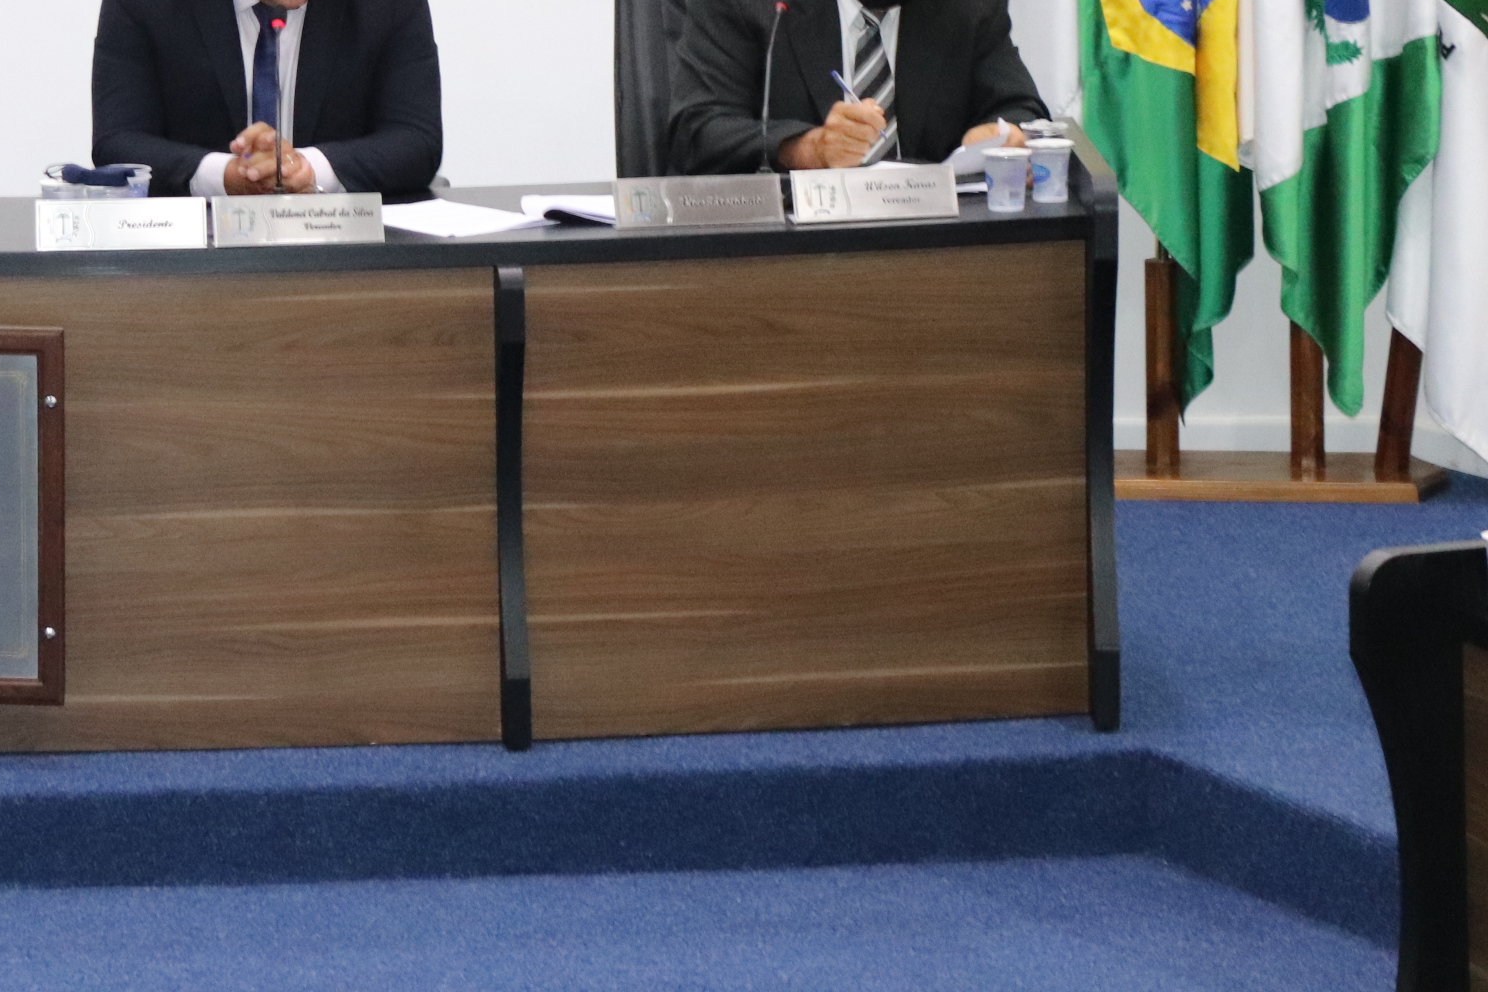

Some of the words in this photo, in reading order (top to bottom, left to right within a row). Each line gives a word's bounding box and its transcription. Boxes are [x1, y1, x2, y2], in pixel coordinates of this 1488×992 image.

[308, 207, 337, 218] Cabral
[339, 207, 350, 217] da
[352, 206, 374, 217] Silva
[117, 218, 174, 230] Presidente
